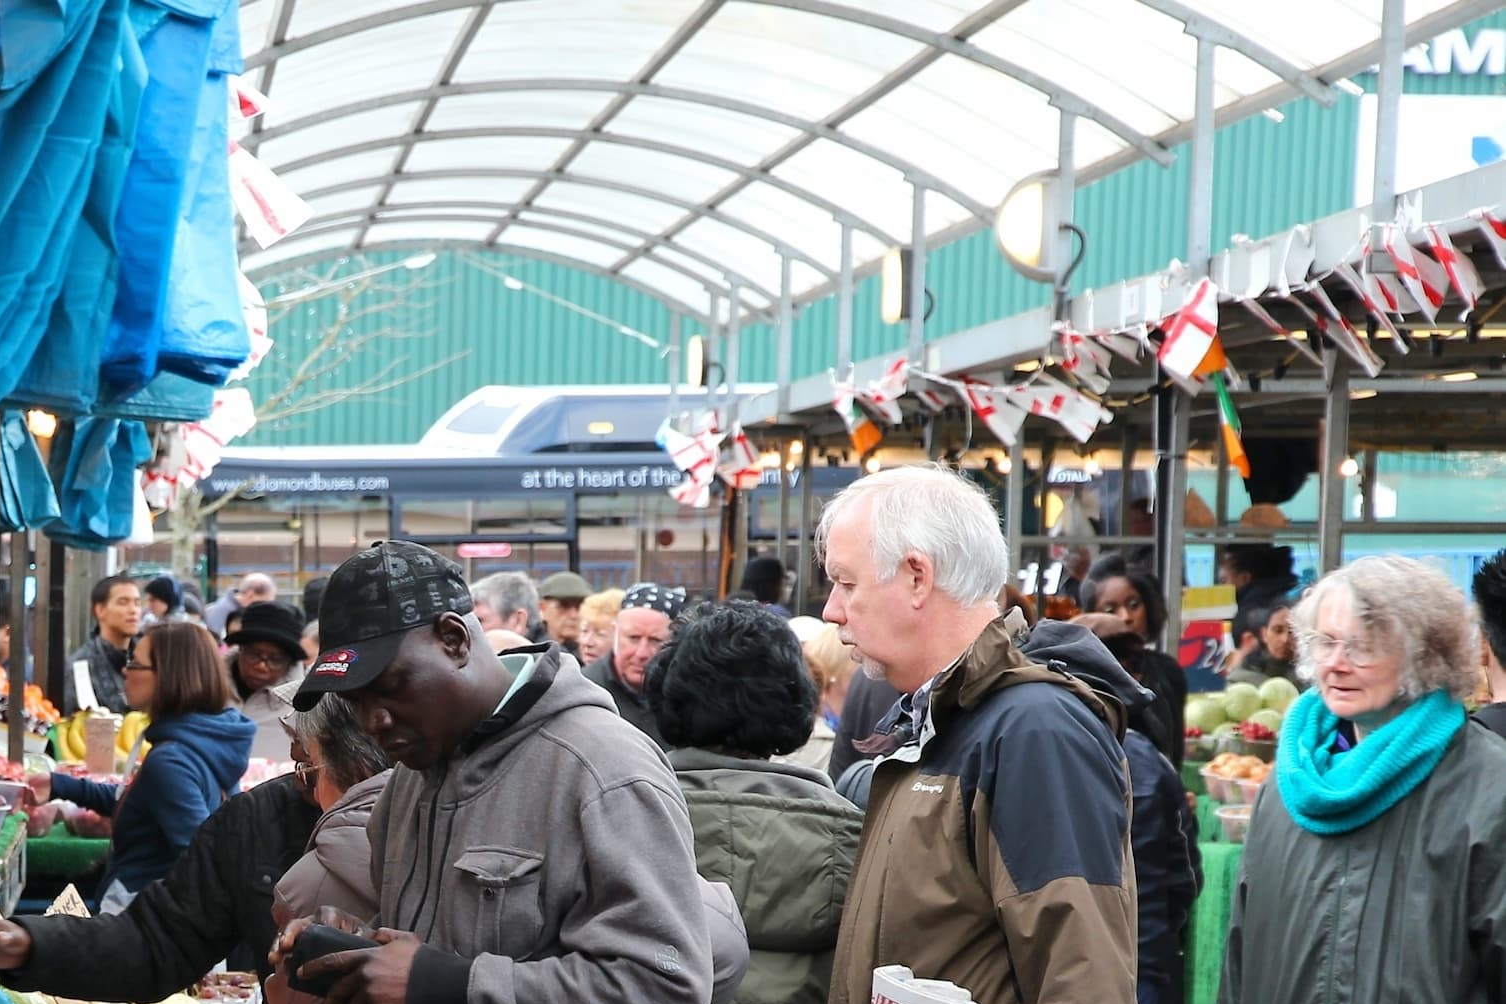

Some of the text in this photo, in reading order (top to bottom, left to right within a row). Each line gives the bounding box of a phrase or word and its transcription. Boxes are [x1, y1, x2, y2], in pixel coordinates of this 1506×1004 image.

[522, 467, 682, 488] at the heart of the
